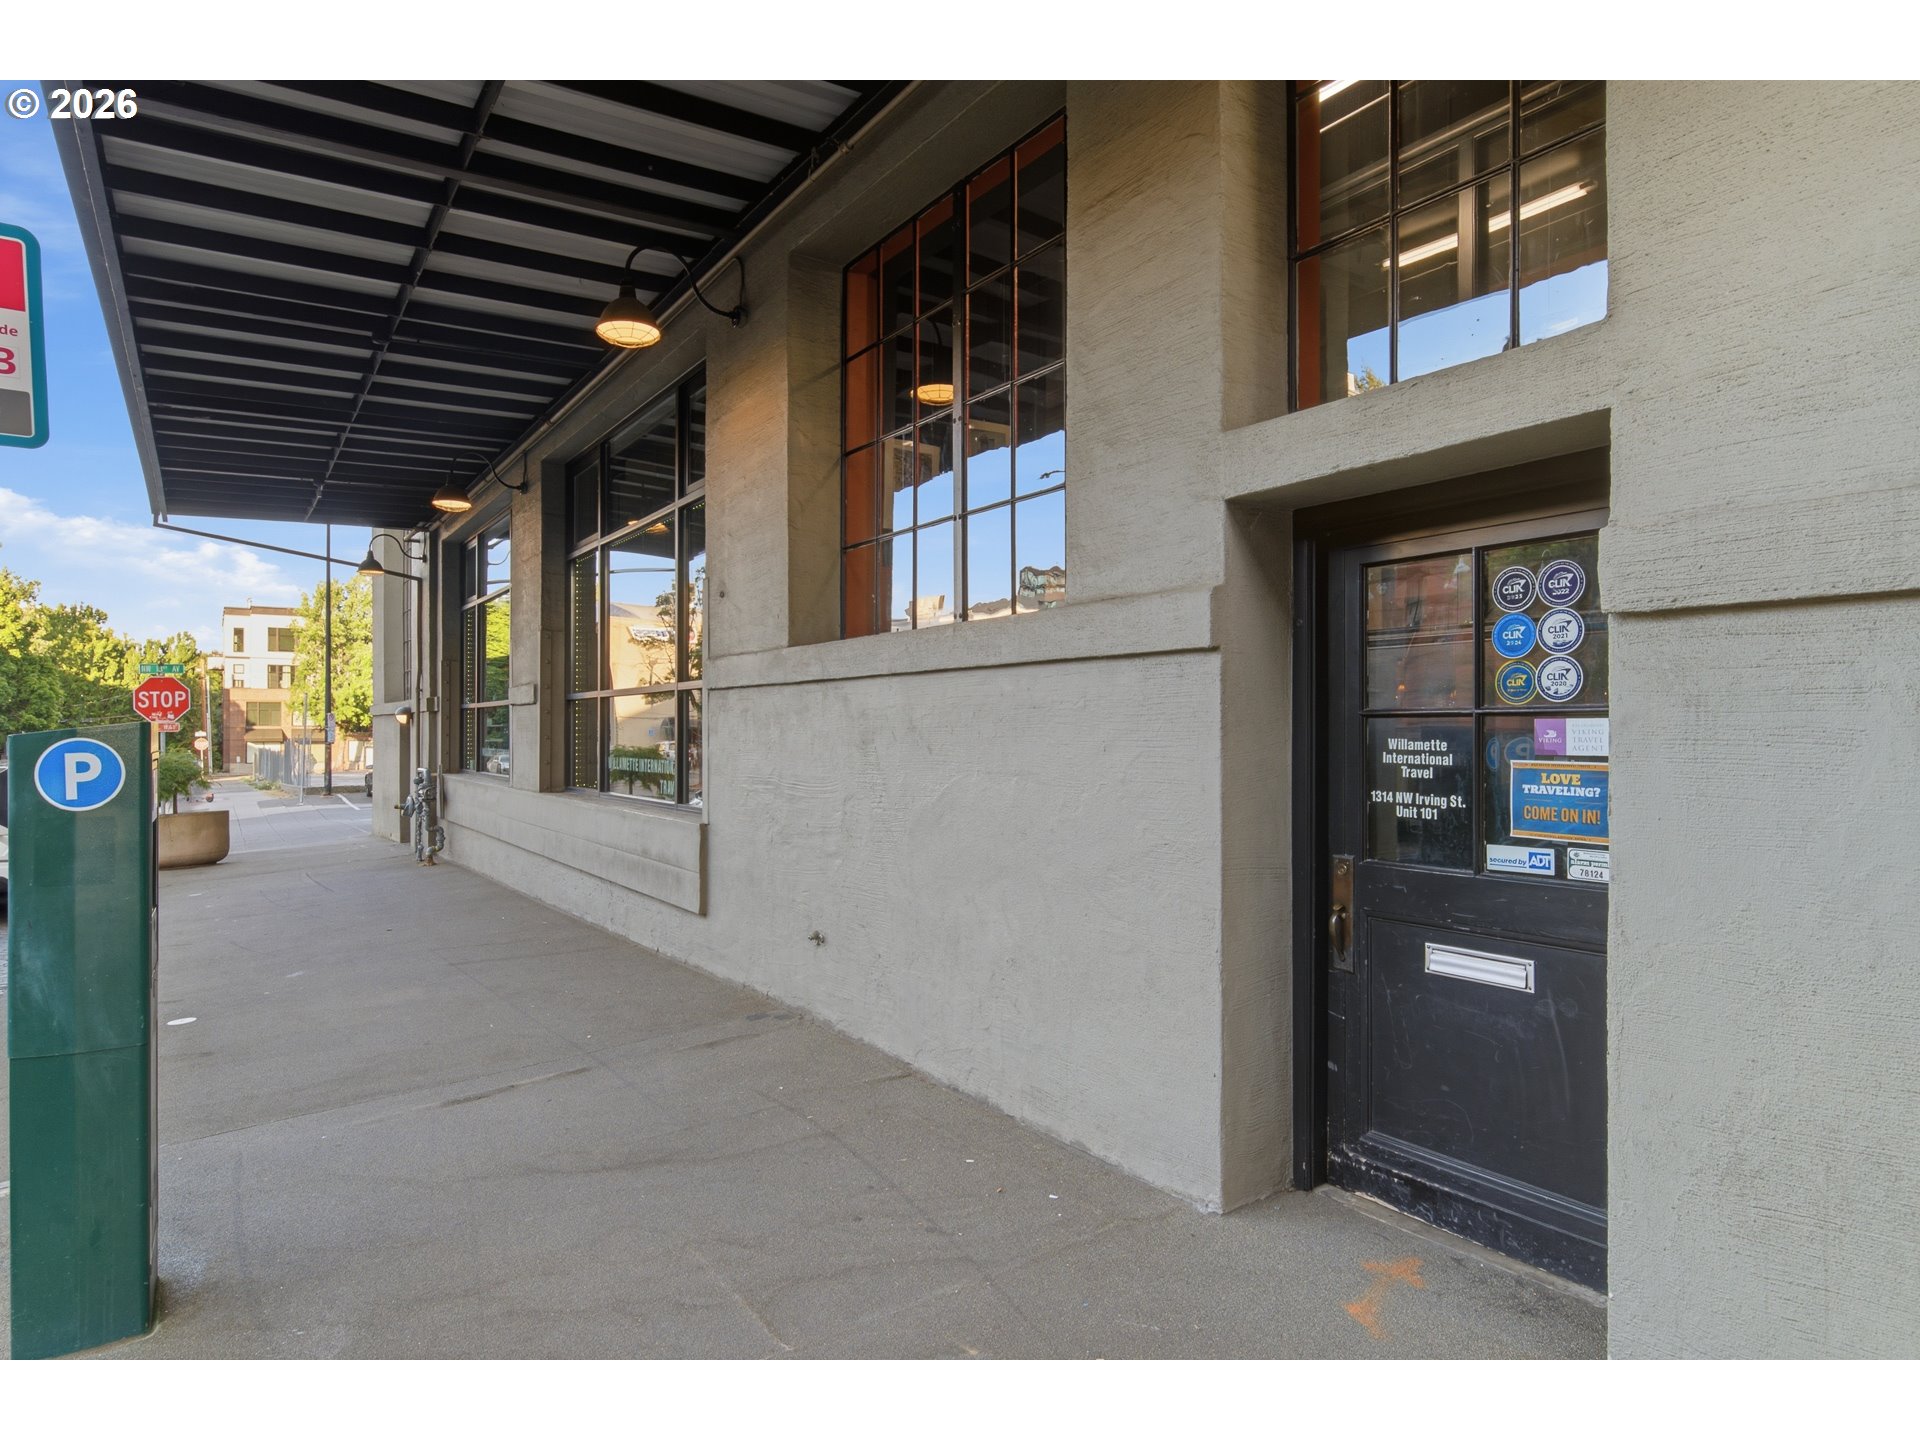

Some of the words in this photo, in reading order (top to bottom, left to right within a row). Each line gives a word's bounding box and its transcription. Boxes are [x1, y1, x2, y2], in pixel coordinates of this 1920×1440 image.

[0, 324, 18, 337] de
[138, 691, 186, 708] STOP
[1388, 738, 1448, 751] Willamette
[1383, 752, 1453, 766] International
[64, 752, 102, 801] P
[1401, 766, 1433, 779] Travel
[1541, 772, 1580, 785] LOVE
[1522, 784, 1601, 798] TRAVELING?
[1371, 790, 1393, 803] 1314
[1396, 792, 1413, 804] NW
[1416, 793, 1447, 809] Irving
[1450, 795, 1466, 808] St.
[1396, 805, 1417, 818] Unit
[1420, 807, 1438, 820] 101
[1523, 805, 1558, 821] COME
[1561, 808, 1579, 823] ON
[1582, 808, 1601, 825] IN!
[1489, 857, 1517, 865] secured
[1518, 858, 1527, 866] by
[1529, 854, 1551, 868] ADT
[1580, 868, 1604, 879] 78124
